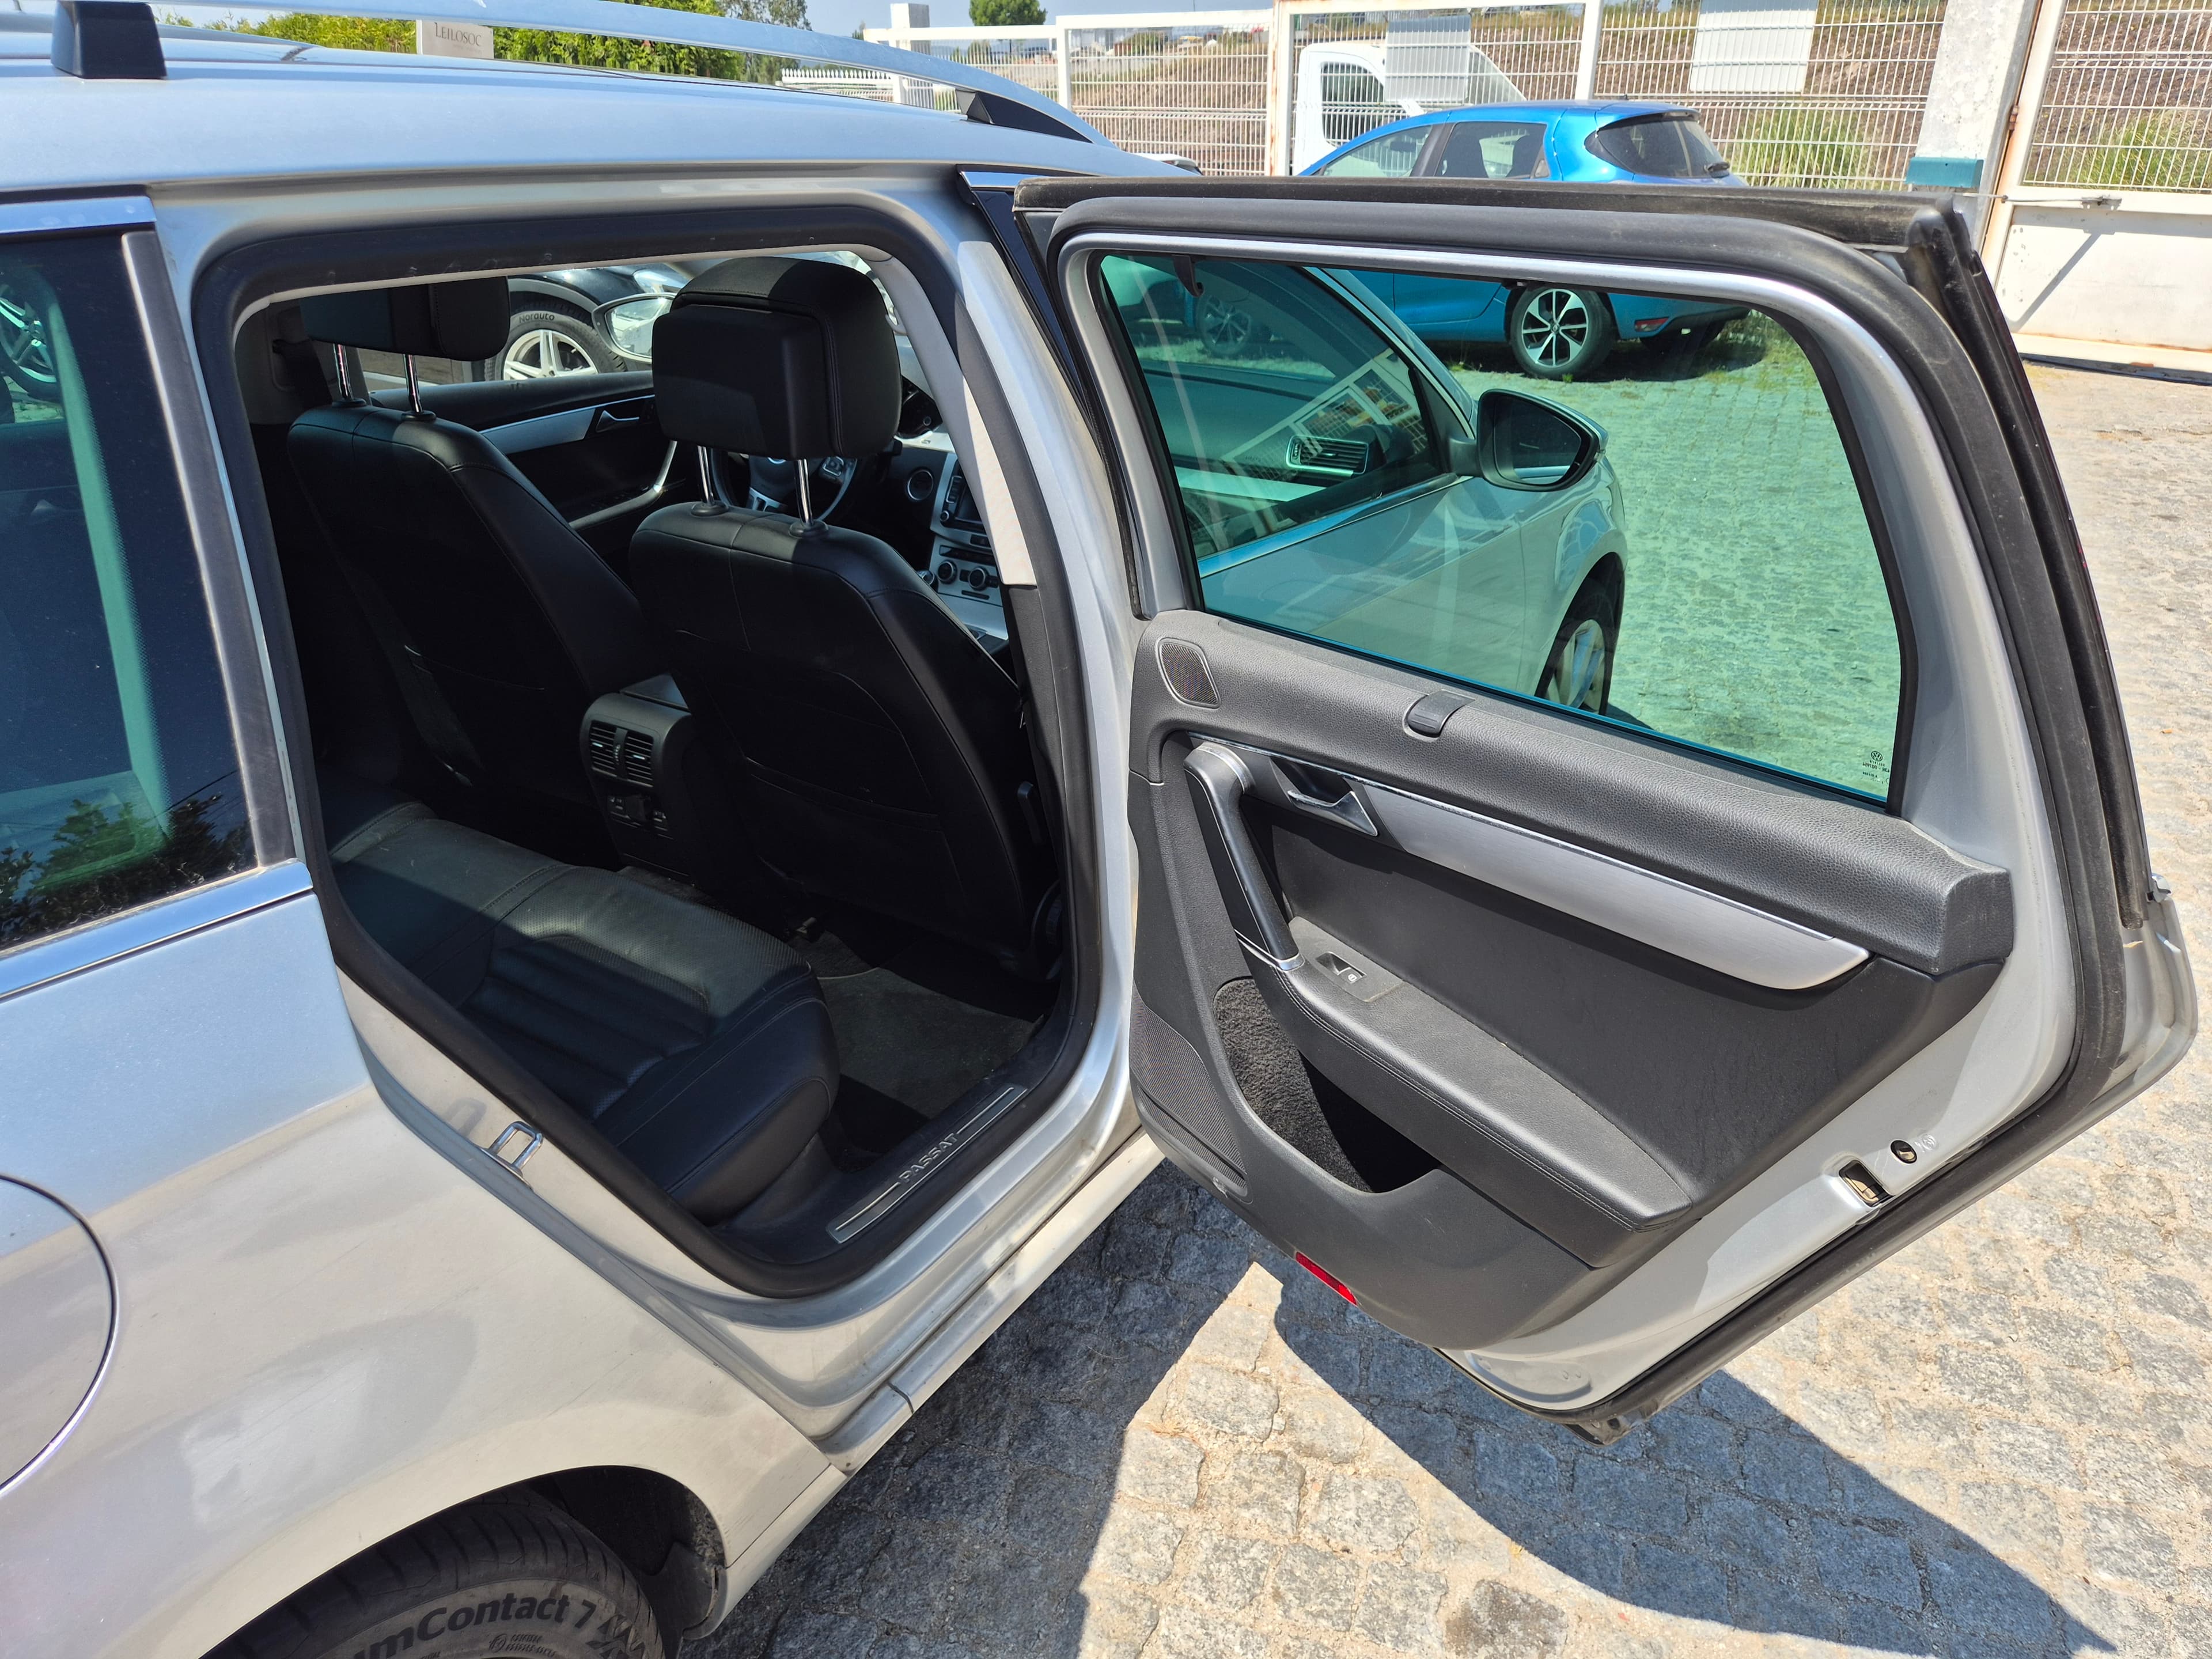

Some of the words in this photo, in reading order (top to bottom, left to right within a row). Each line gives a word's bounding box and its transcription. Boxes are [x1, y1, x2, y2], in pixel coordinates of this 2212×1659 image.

[434, 22, 482, 46] LEILOSOC
[519, 313, 555, 323] Norauto
[899, 1132, 957, 1183] PASSAT
[354, 1593, 570, 1659] mContact
[574, 1599, 597, 1629] 7
